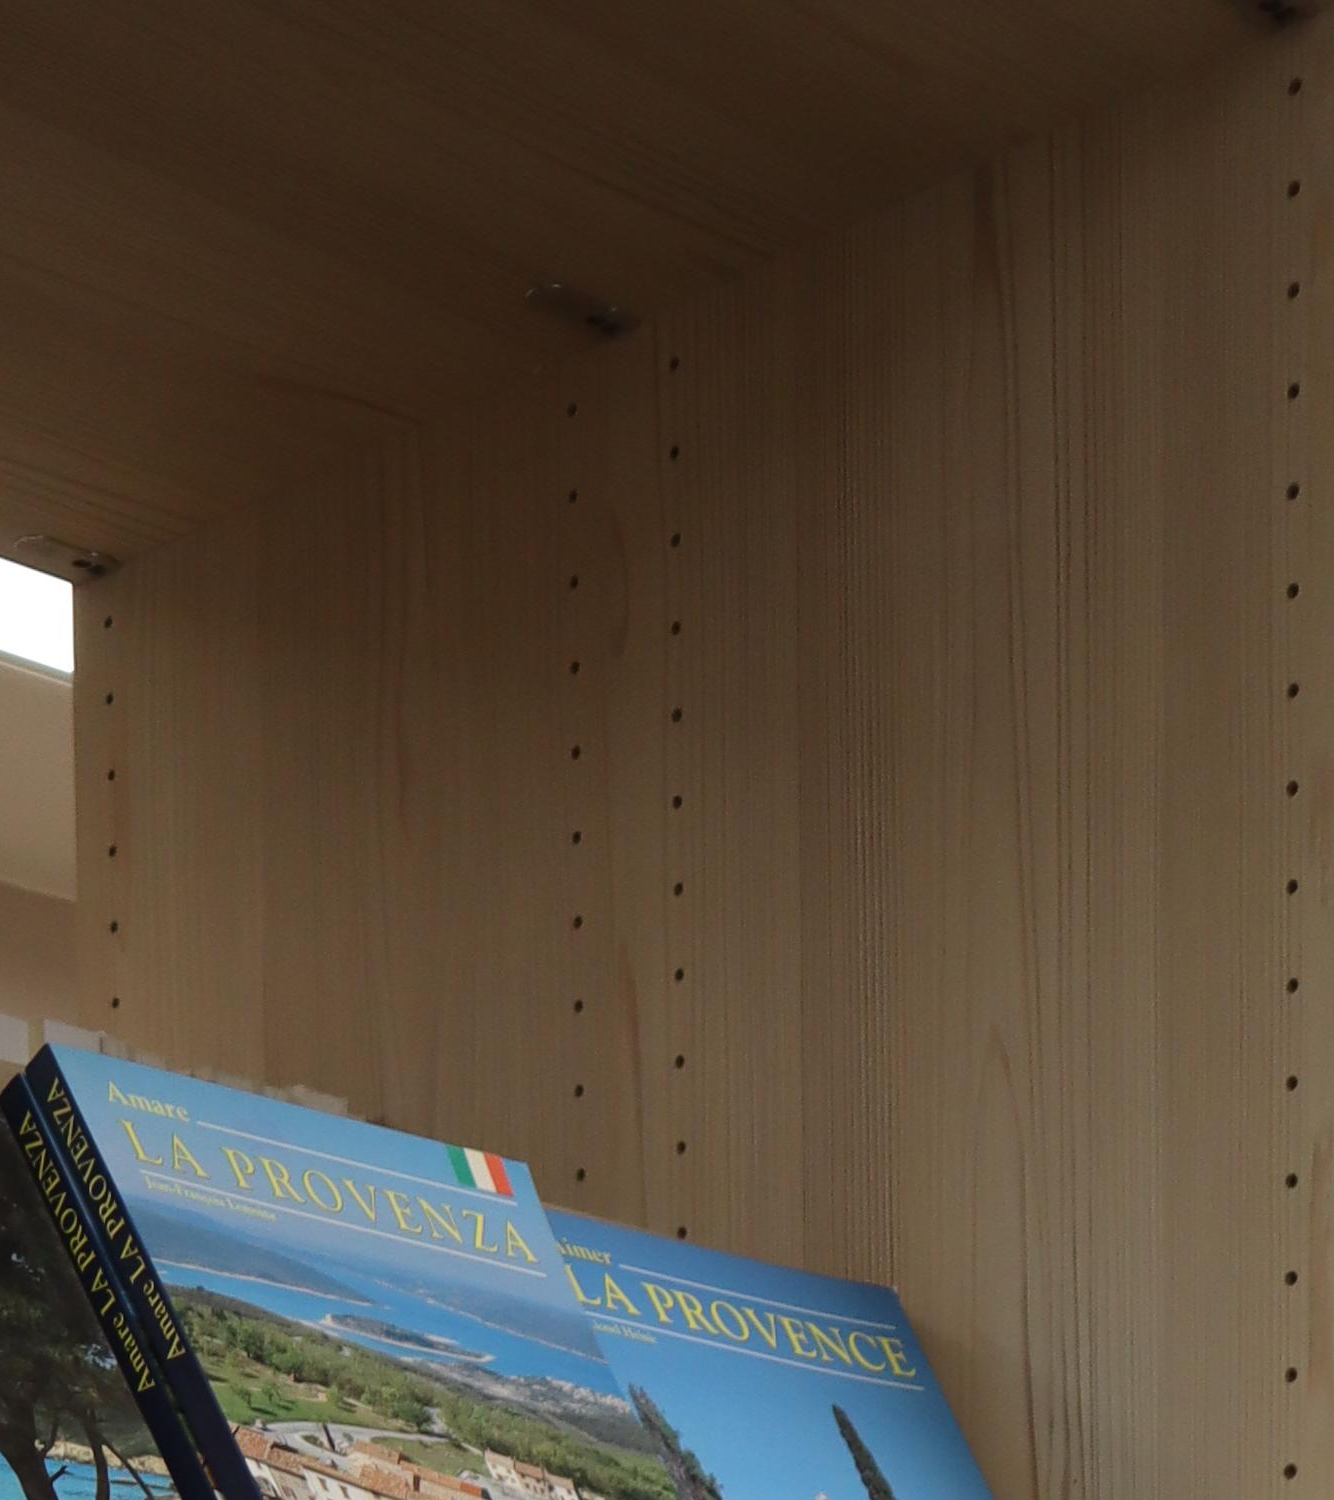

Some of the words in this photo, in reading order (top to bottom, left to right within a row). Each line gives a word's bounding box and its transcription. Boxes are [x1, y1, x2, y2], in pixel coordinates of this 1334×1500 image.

[108, 1081, 190, 1122] Amare
[47, 1077, 124, 1240] PROVENZA
[121, 1120, 210, 1179] LA
[221, 1146, 541, 1264] PROVENZA
[121, 1235, 146, 1286] LA
[143, 1280, 186, 1360] Amare
[564, 1264, 641, 1316] LA
[641, 1281, 916, 1378] PROVENCE
